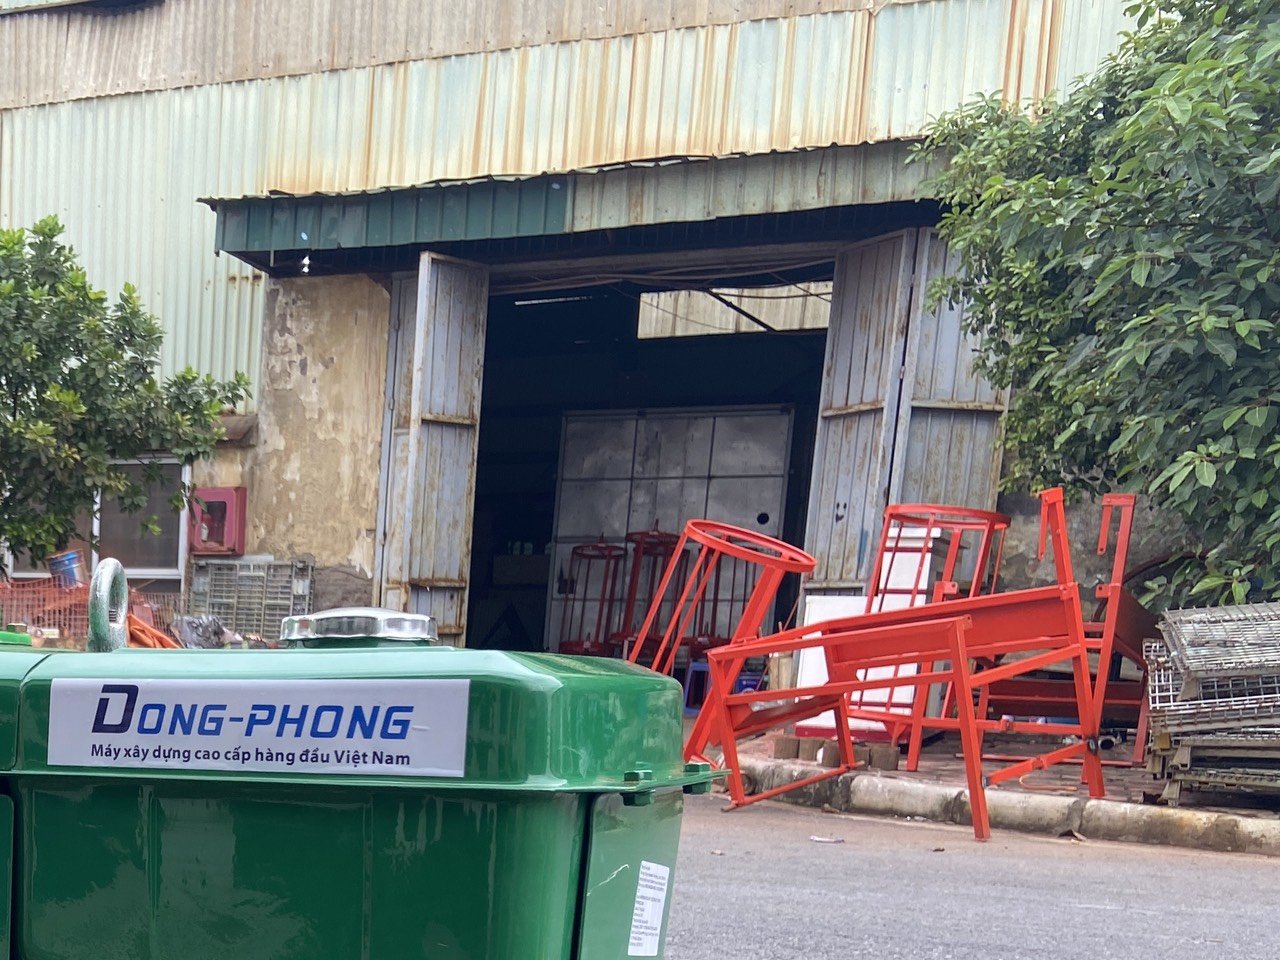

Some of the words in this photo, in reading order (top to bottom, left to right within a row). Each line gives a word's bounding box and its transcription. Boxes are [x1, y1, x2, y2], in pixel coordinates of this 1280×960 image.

[91, 684, 414, 740] DONG-PHONG
[91, 744, 121, 761] Máy
[123, 745, 149, 762] xây
[152, 745, 191, 763] dựng
[194, 749, 221, 760] cao
[224, 746, 251, 764] cấp
[255, 748, 295, 766] hàng
[334, 750, 368, 768] Việt
[371, 751, 411, 765] Nam
